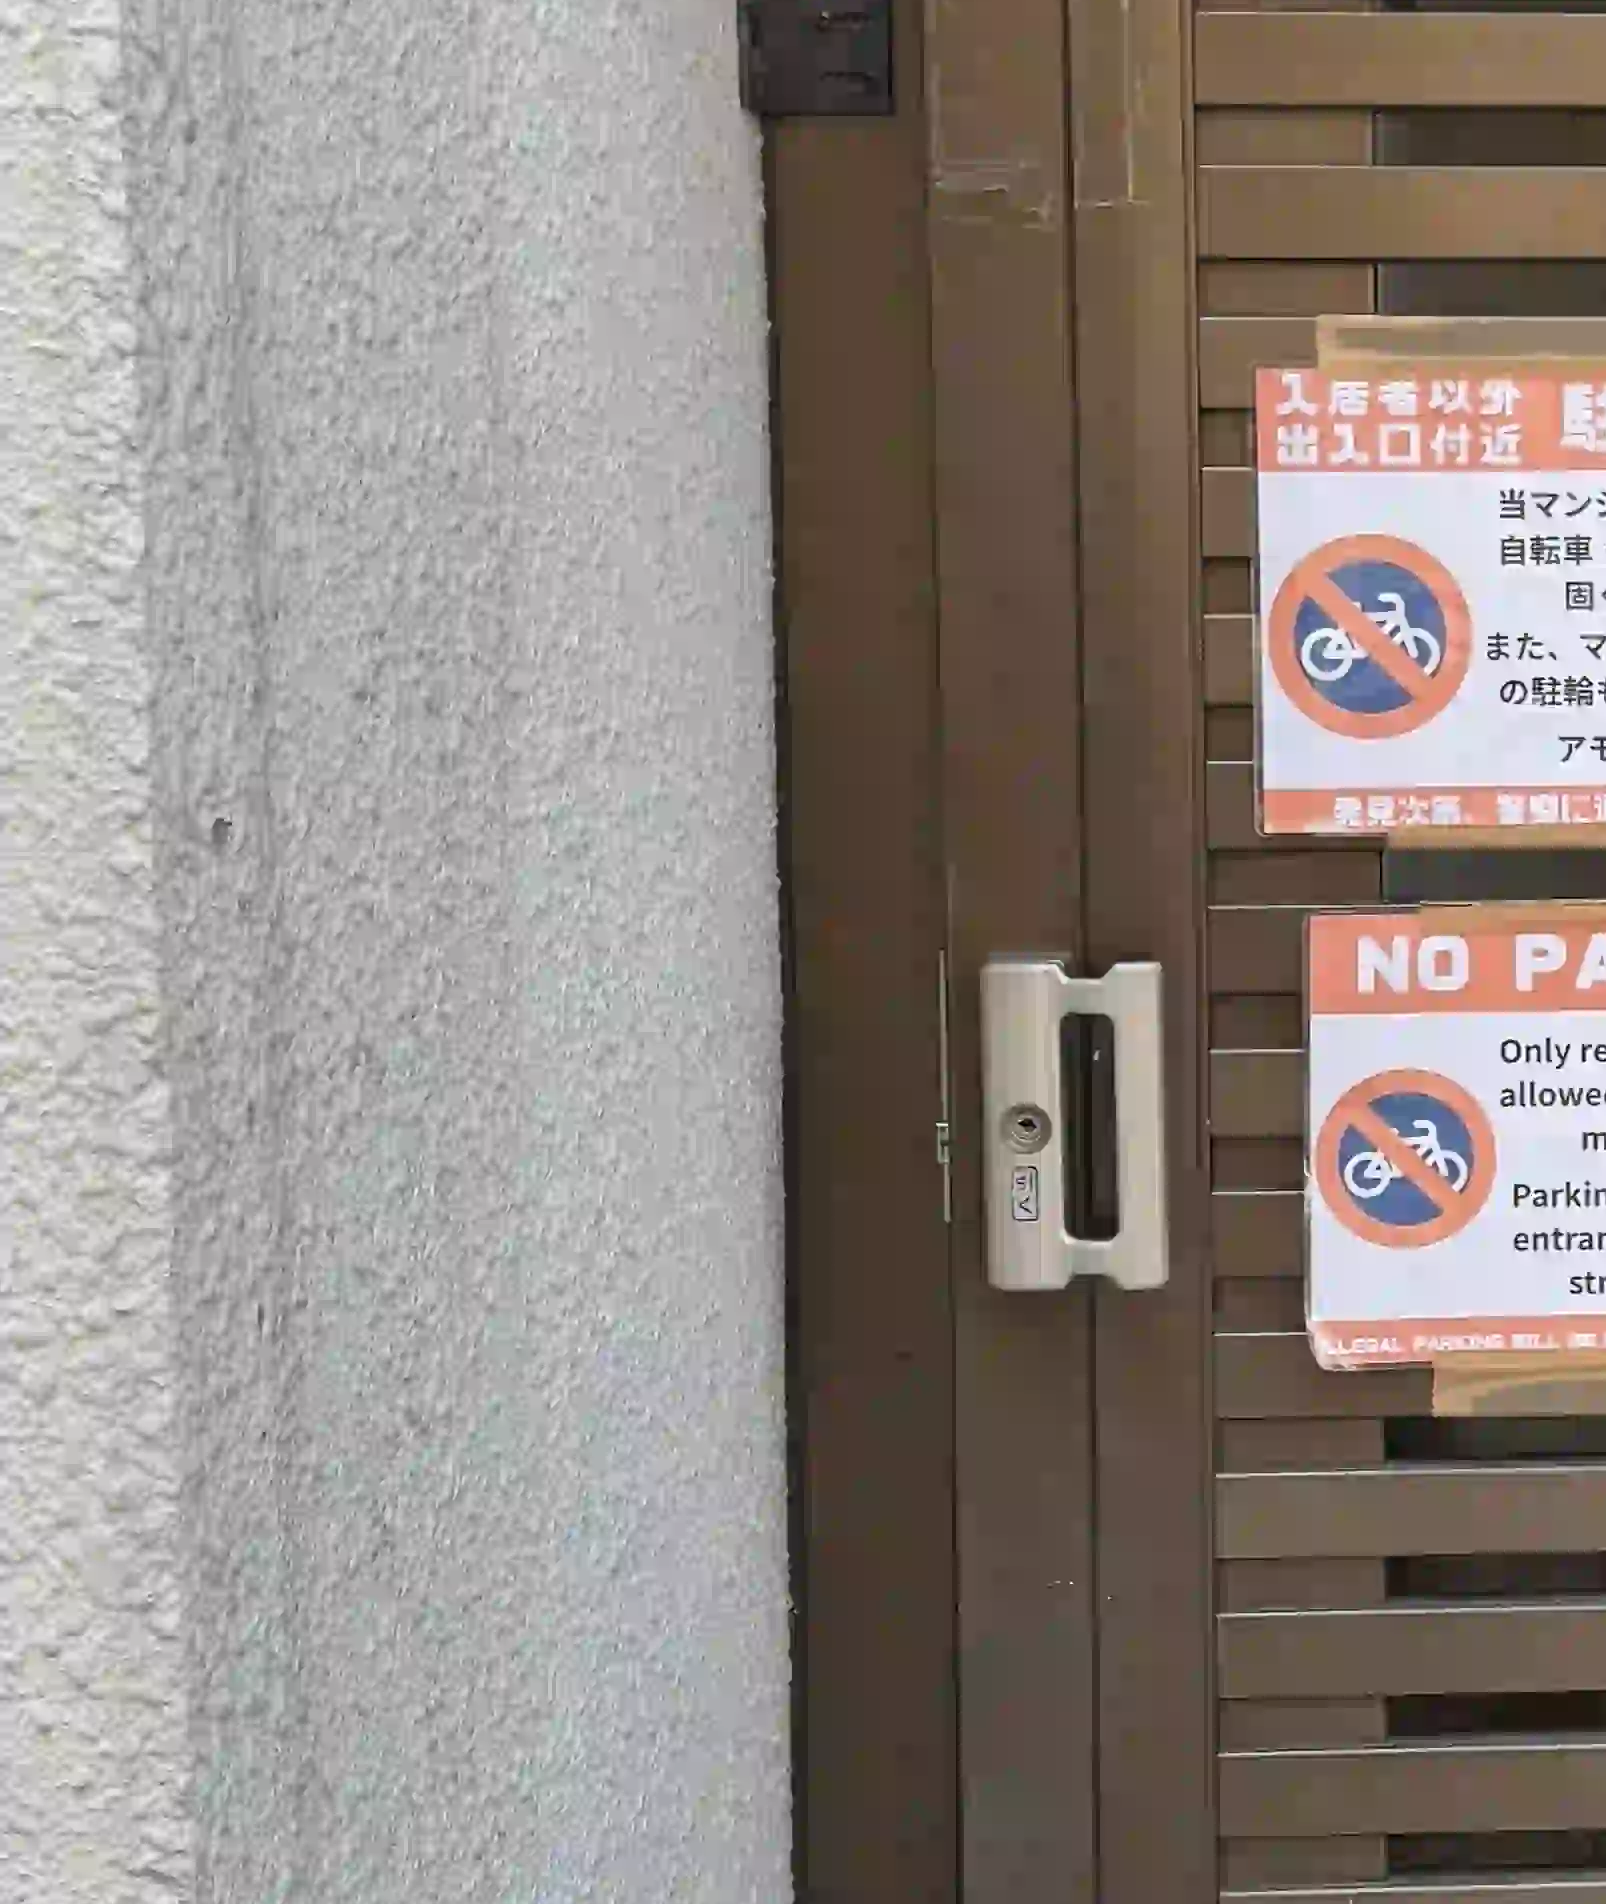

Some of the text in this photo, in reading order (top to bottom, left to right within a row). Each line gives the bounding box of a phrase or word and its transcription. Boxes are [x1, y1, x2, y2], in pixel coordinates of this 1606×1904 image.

[1276, 371, 1523, 417] 入居者以外
[1277, 422, 1523, 467] 出入口付近
[1357, 935, 1469, 993] NO
[1500, 1037, 1571, 1070] Only
[1320, 1336, 1403, 1355] LLEGAL
